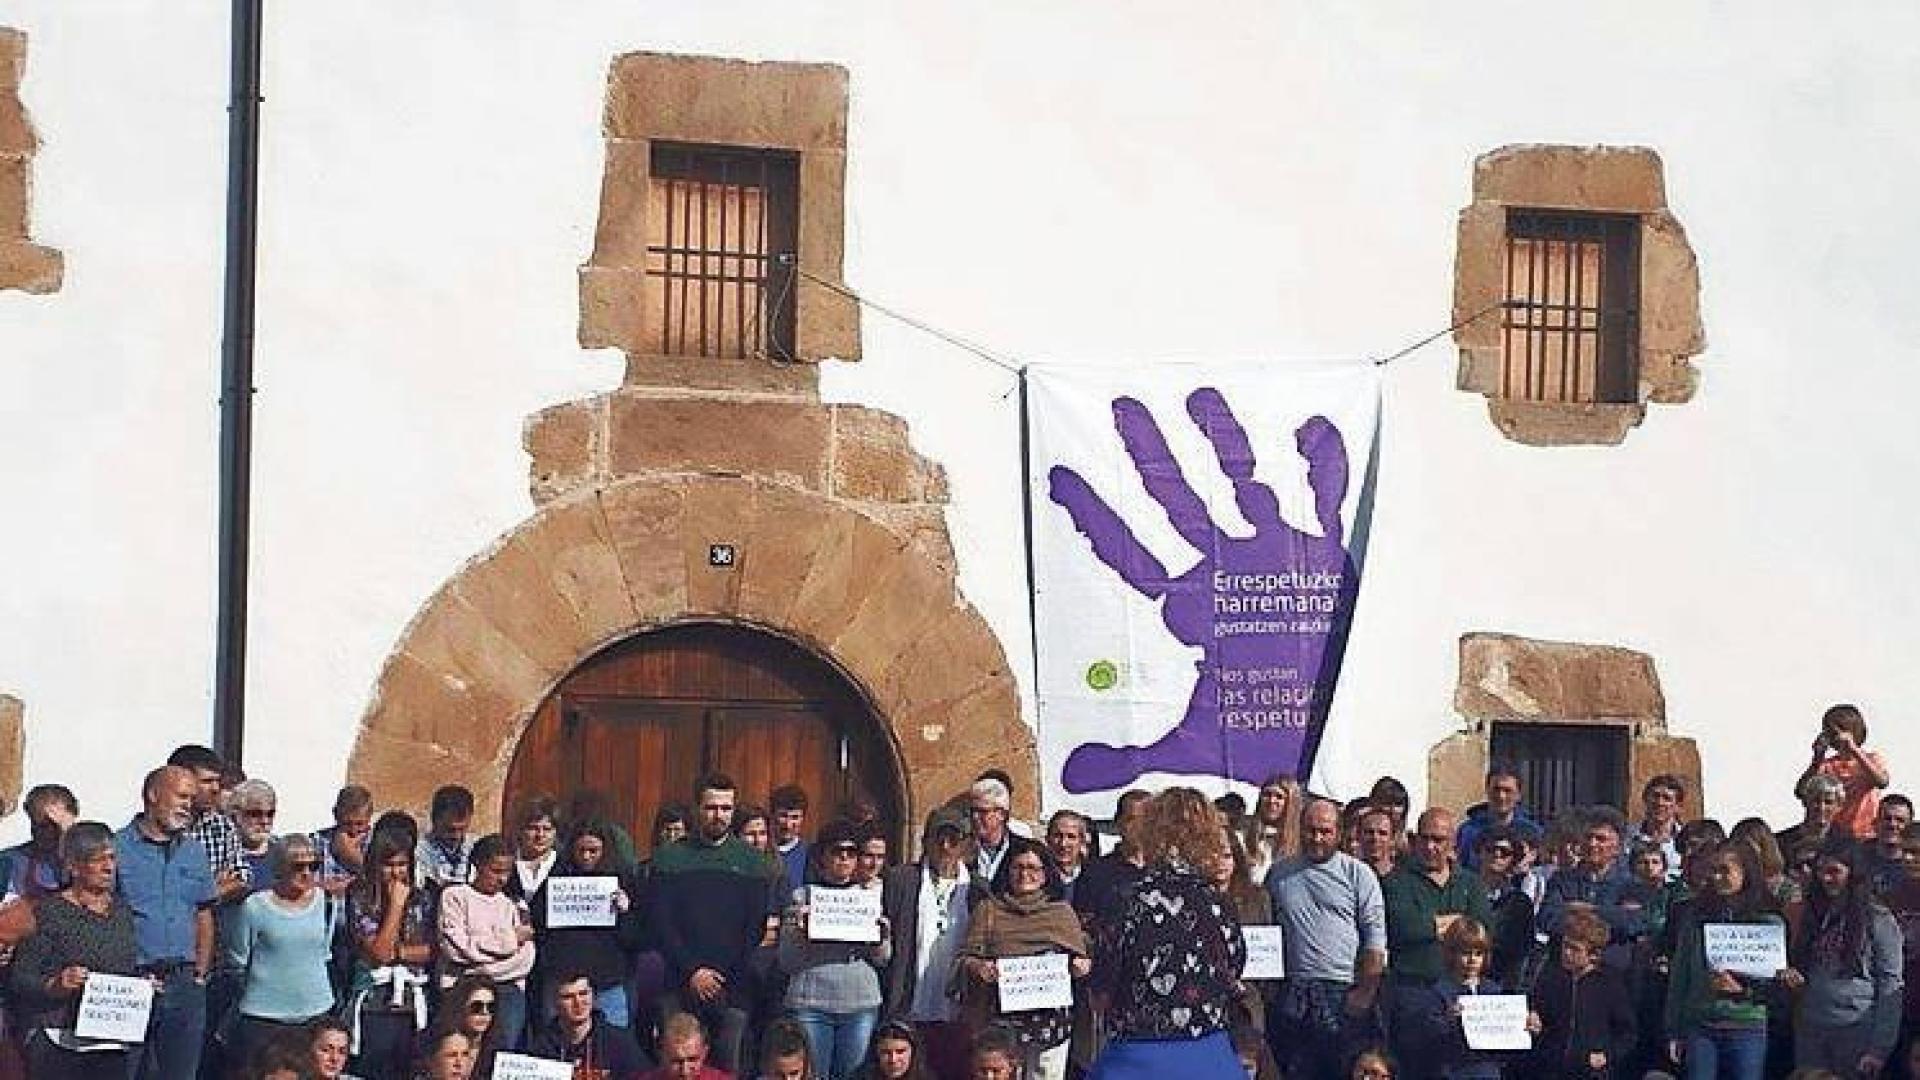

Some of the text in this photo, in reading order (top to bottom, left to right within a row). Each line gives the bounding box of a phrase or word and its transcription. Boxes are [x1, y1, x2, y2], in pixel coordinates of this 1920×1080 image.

[712, 546, 732, 563] 36
[1214, 592, 1339, 613] harremana
[1216, 687, 1246, 705] las
[1217, 709, 1306, 731] respetu
